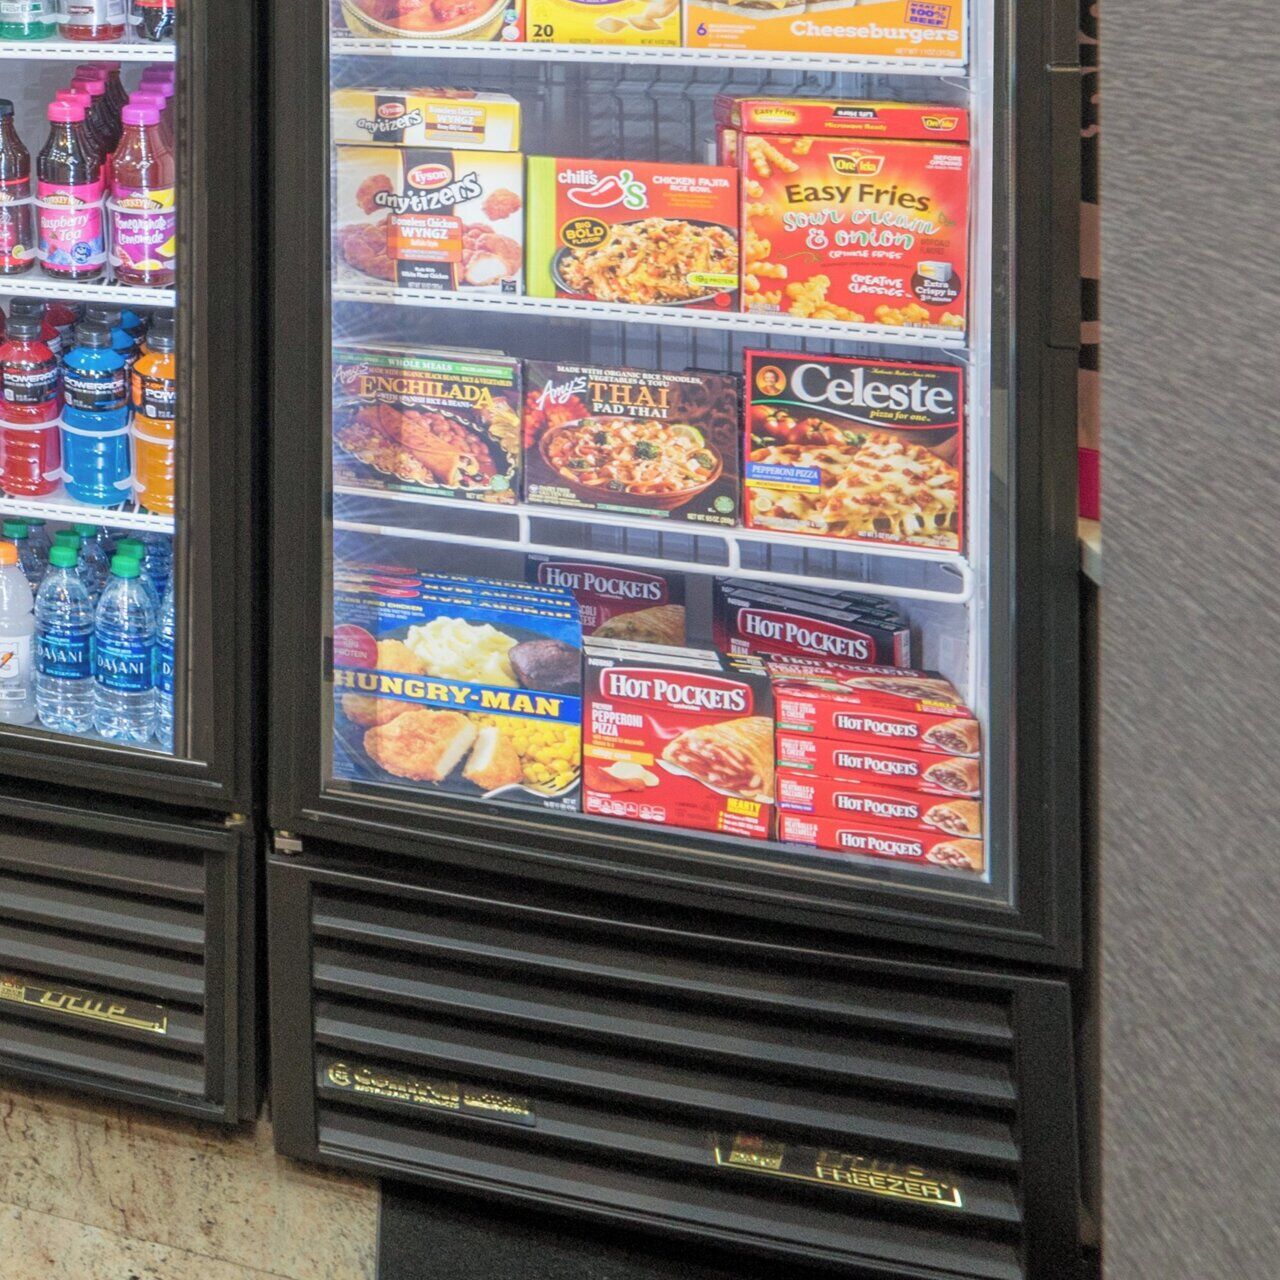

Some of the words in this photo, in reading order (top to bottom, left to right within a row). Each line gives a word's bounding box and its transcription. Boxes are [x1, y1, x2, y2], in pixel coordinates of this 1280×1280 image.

[532, 23, 554, 37] 20
[790, 20, 959, 44] Cheeseburgers
[412, 168, 450, 183] Tyson
[652, 175, 695, 186] CHICKEN
[698, 178, 730, 187] FAJITA
[785, 183, 851, 205] Easy
[859, 184, 930, 212] Fries
[400, 226, 448, 239] WYNGZ
[565, 226, 605, 240] BOLD
[783, 210, 844, 233] sour
[852, 210, 941, 235] cream
[59, 229, 82, 241] Tea
[806, 230, 828, 250] &
[835, 231, 914, 251] onion
[851, 274, 903, 289] CREATIVE
[359, 376, 494, 410] ENCHILADA
[536, 376, 589, 411] Amy's
[588, 381, 671, 410] THAI
[791, 363, 954, 414] Celeste
[593, 403, 625, 415] PAD
[627, 405, 668, 418] THAI
[546, 568, 581, 588] HOT
[584, 571, 661, 600] POCKETS
[746, 614, 783, 636] HOT
[785, 625, 869, 660] POCKETS
[40, 645, 83, 664] DASANI
[98, 655, 143, 675] DASANI
[334, 670, 560, 717] HUNGRY-MAN
[611, 674, 648, 697] HOT
[654, 679, 746, 711] POCKETS
[592, 709, 643, 728] PEPPERONI
[592, 722, 618, 737] PIZZA
[838, 715, 865, 730] HOT
[866, 720, 918, 737] POCKETS
[838, 754, 865, 768] HOT
[866, 758, 918, 776] POCKETS
[838, 795, 865, 811] HOT
[866, 798, 919, 817] POCKETS
[841, 833, 869, 848] HOT
[870, 836, 922, 857] POCKETS
[816, 1165, 942, 1201] FREEZER
